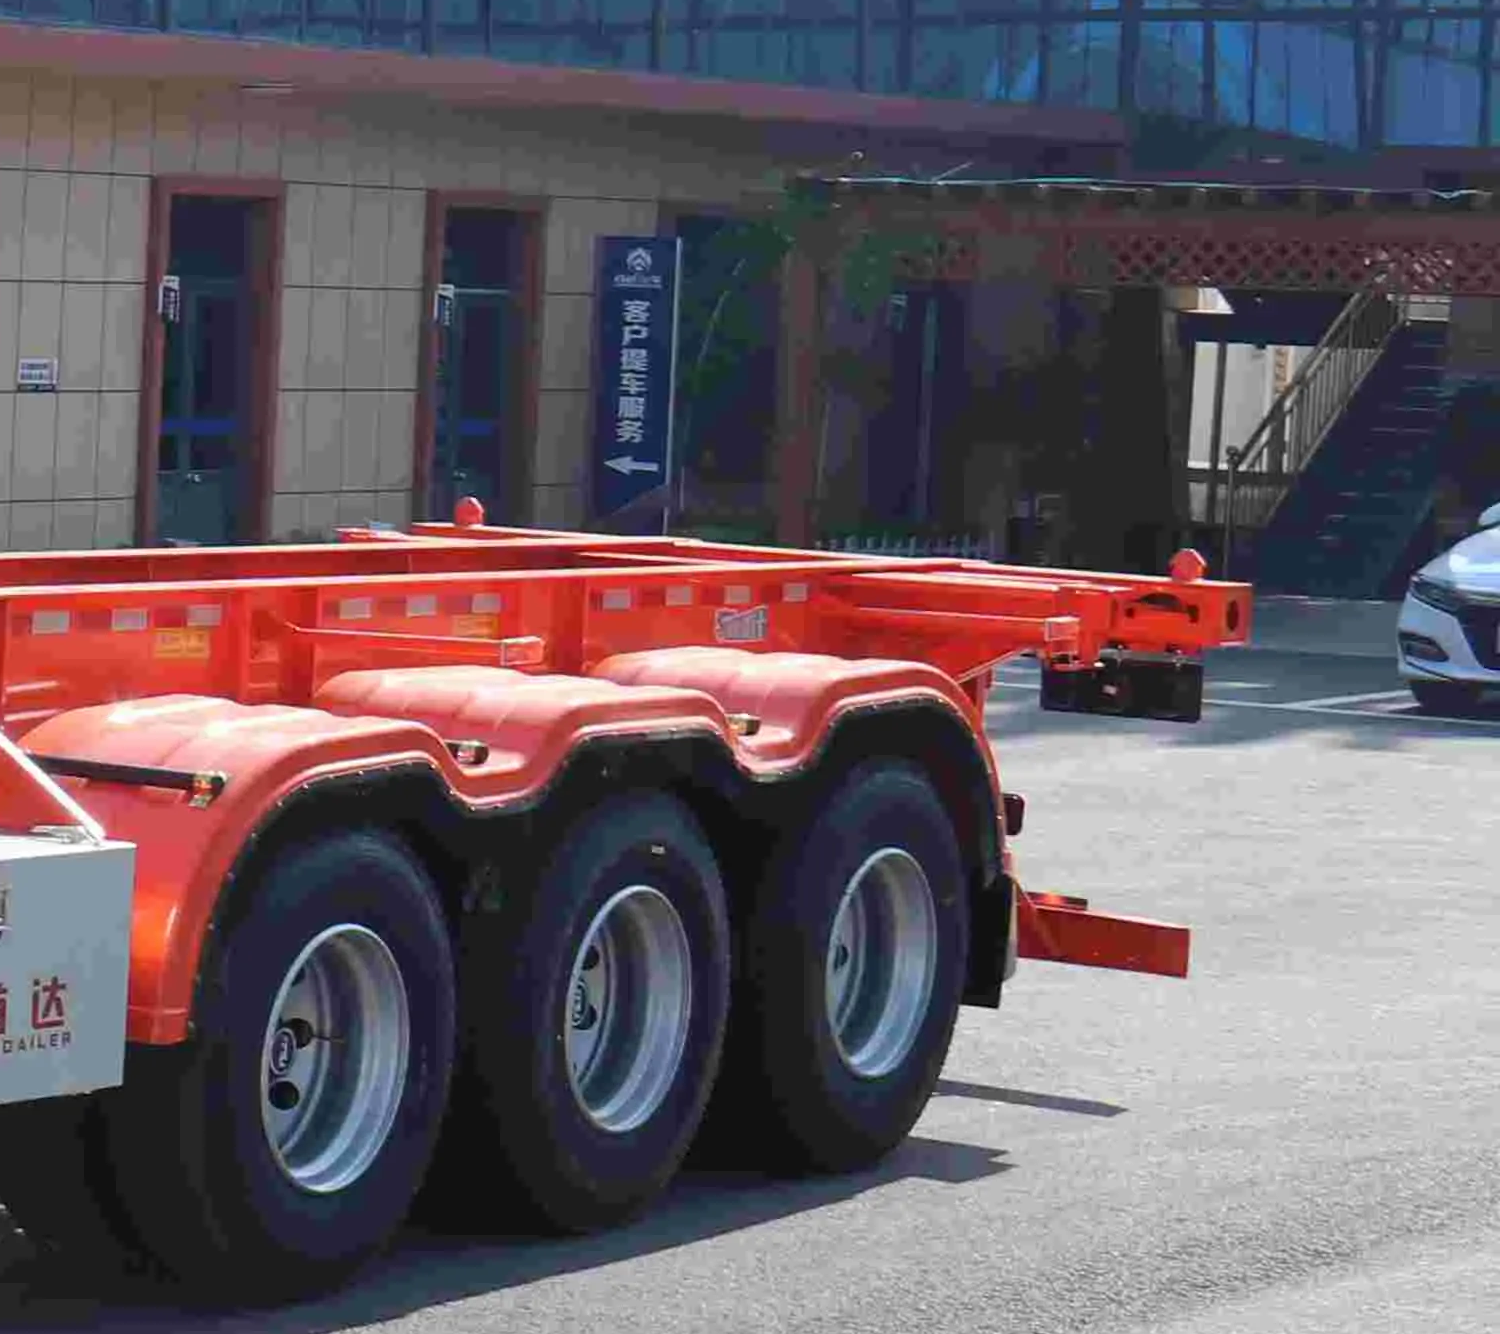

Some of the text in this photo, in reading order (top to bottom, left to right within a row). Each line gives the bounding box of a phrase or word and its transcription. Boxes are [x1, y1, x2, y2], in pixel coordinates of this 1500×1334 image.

[615, 299, 651, 444] 客户提车服务
